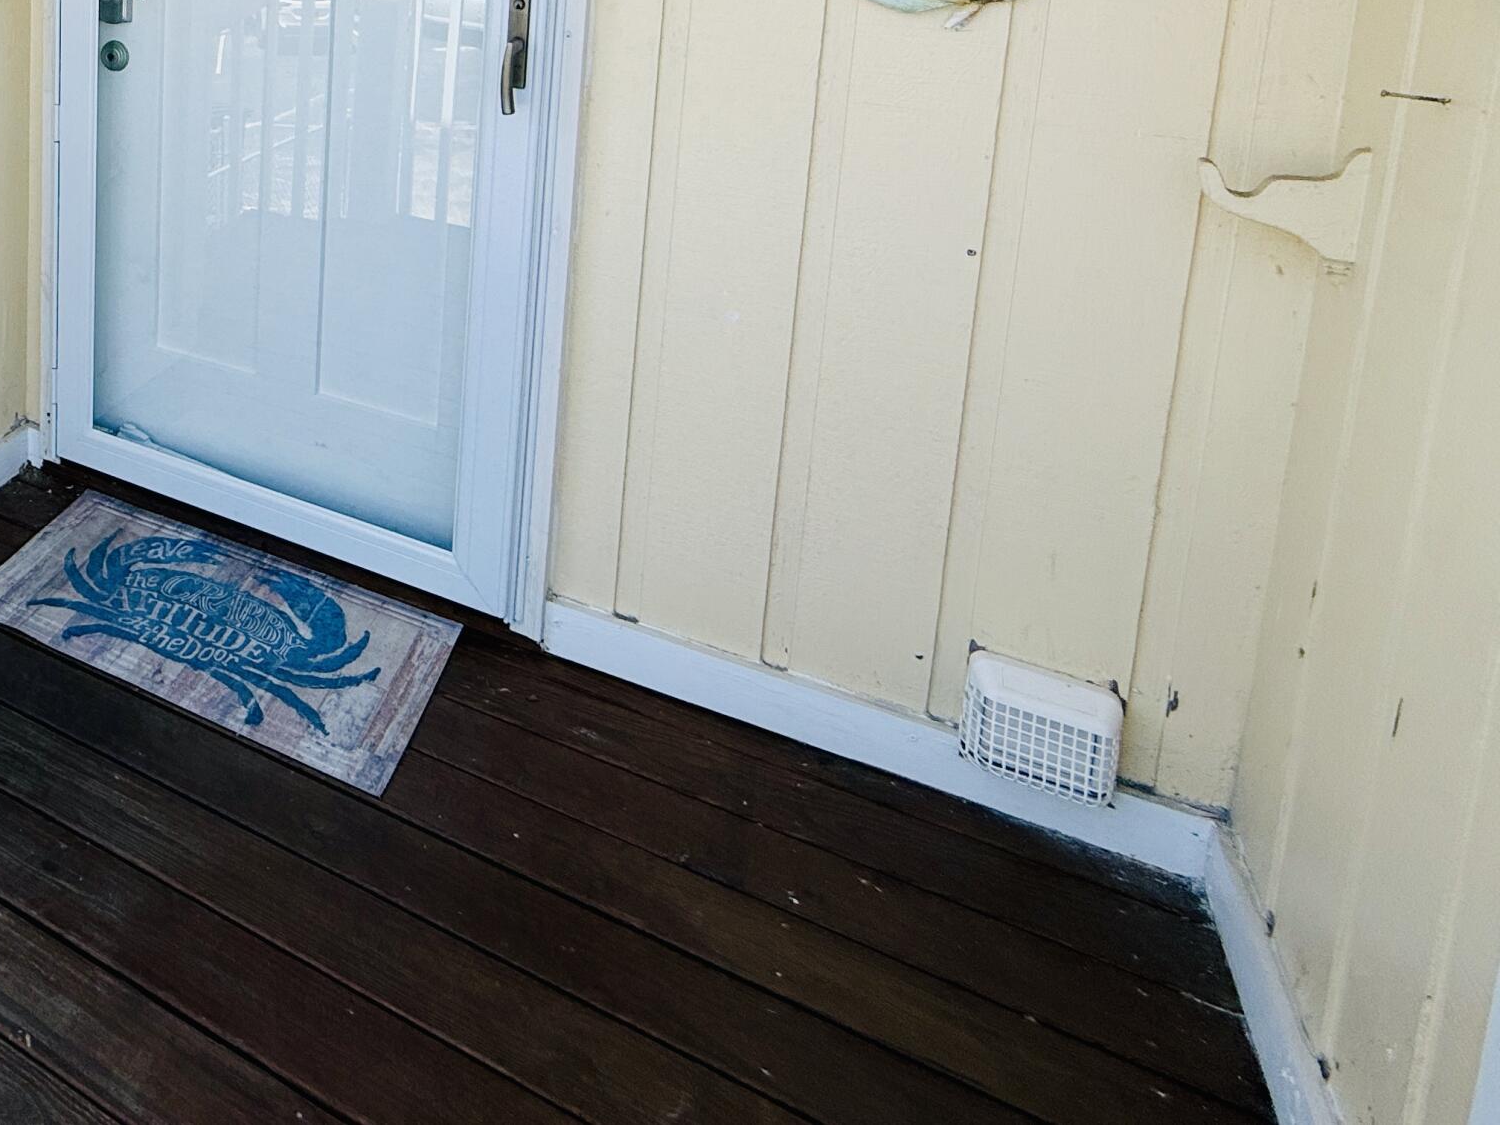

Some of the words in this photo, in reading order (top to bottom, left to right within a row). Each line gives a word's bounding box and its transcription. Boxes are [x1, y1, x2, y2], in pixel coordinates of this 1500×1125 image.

[119, 539, 194, 566] Leave
[124, 572, 159, 588] the
[160, 575, 308, 664] CRABBY
